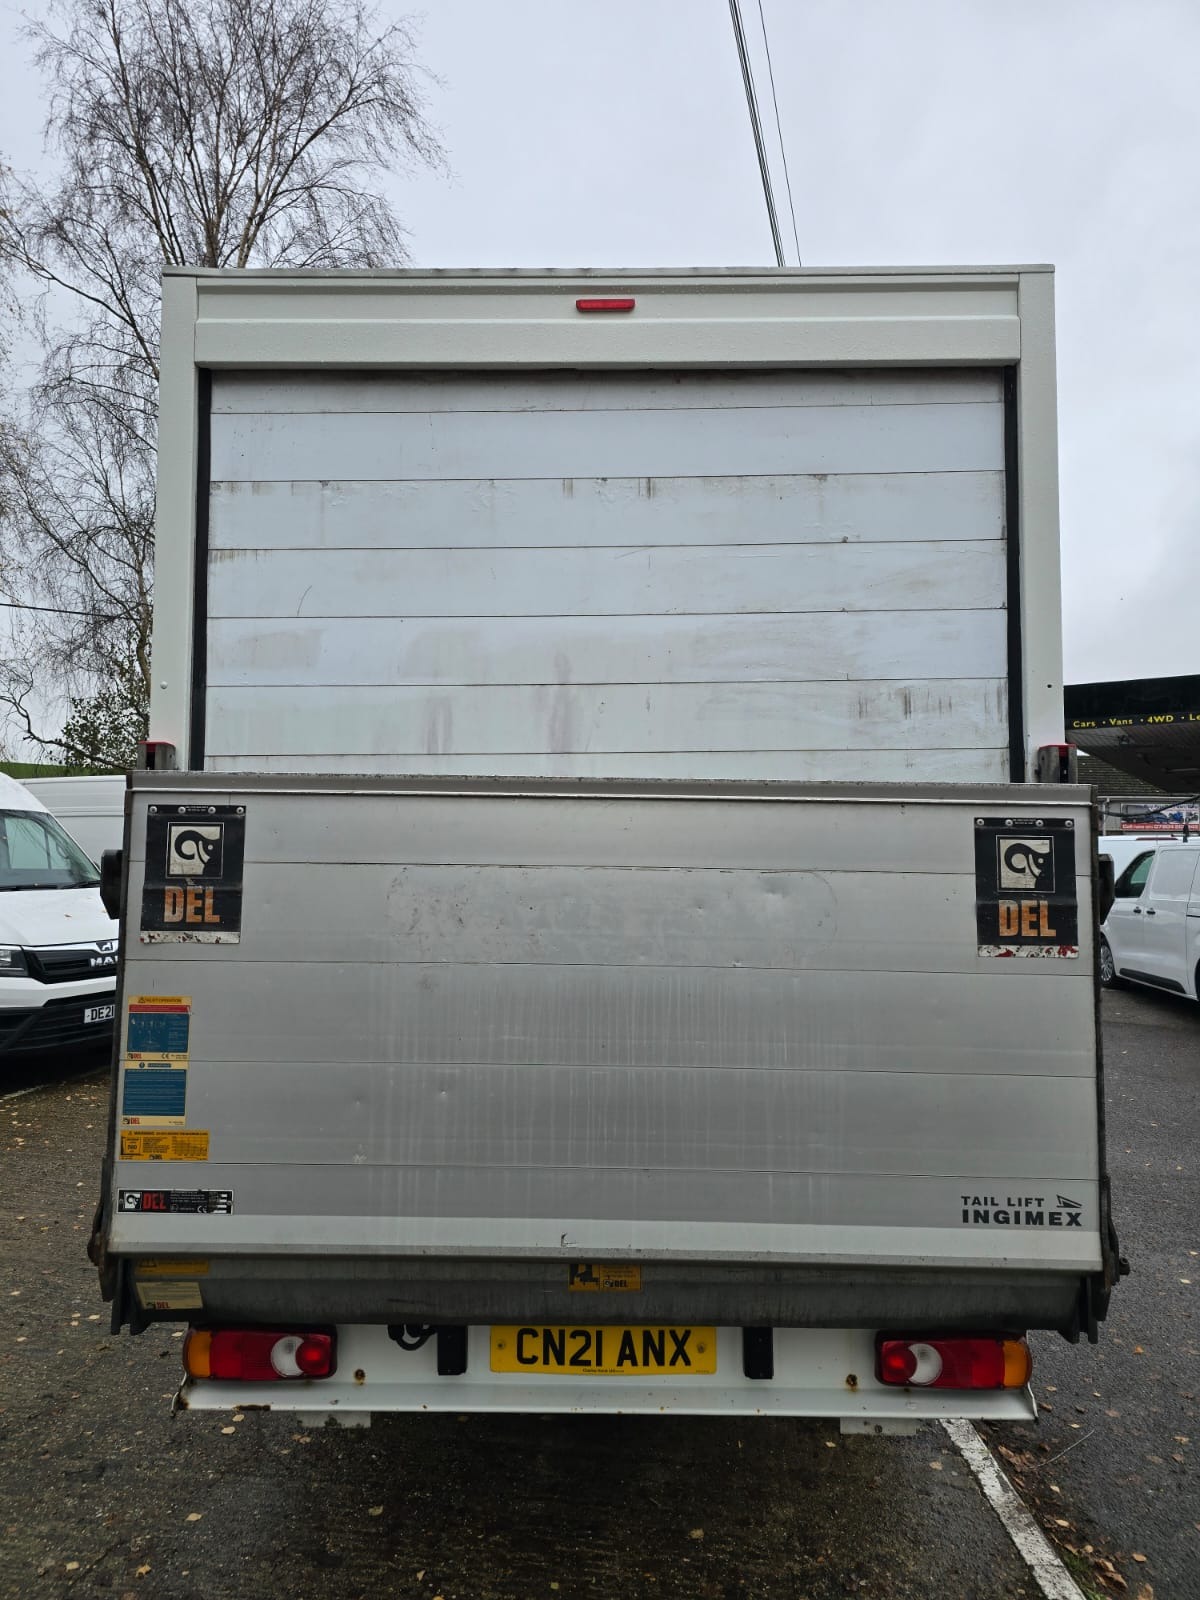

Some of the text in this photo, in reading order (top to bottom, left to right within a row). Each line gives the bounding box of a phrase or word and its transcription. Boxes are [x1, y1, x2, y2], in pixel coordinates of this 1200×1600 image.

[1073, 720, 1096, 728] Cars
[1109, 718, 1133, 726] Vans
[1147, 714, 1174, 724] 4WD
[164, 886, 221, 923] DEL
[998, 899, 1057, 937] DEL
[90, 955, 118, 967] MA
[90, 1005, 114, 1021] DE21
[142, 1193, 167, 1210] DEL
[961, 1196, 1044, 1207] TAIL LIFT
[962, 1209, 1082, 1226] INGIMEX
[516, 1328, 692, 1367] CN21 ANX
